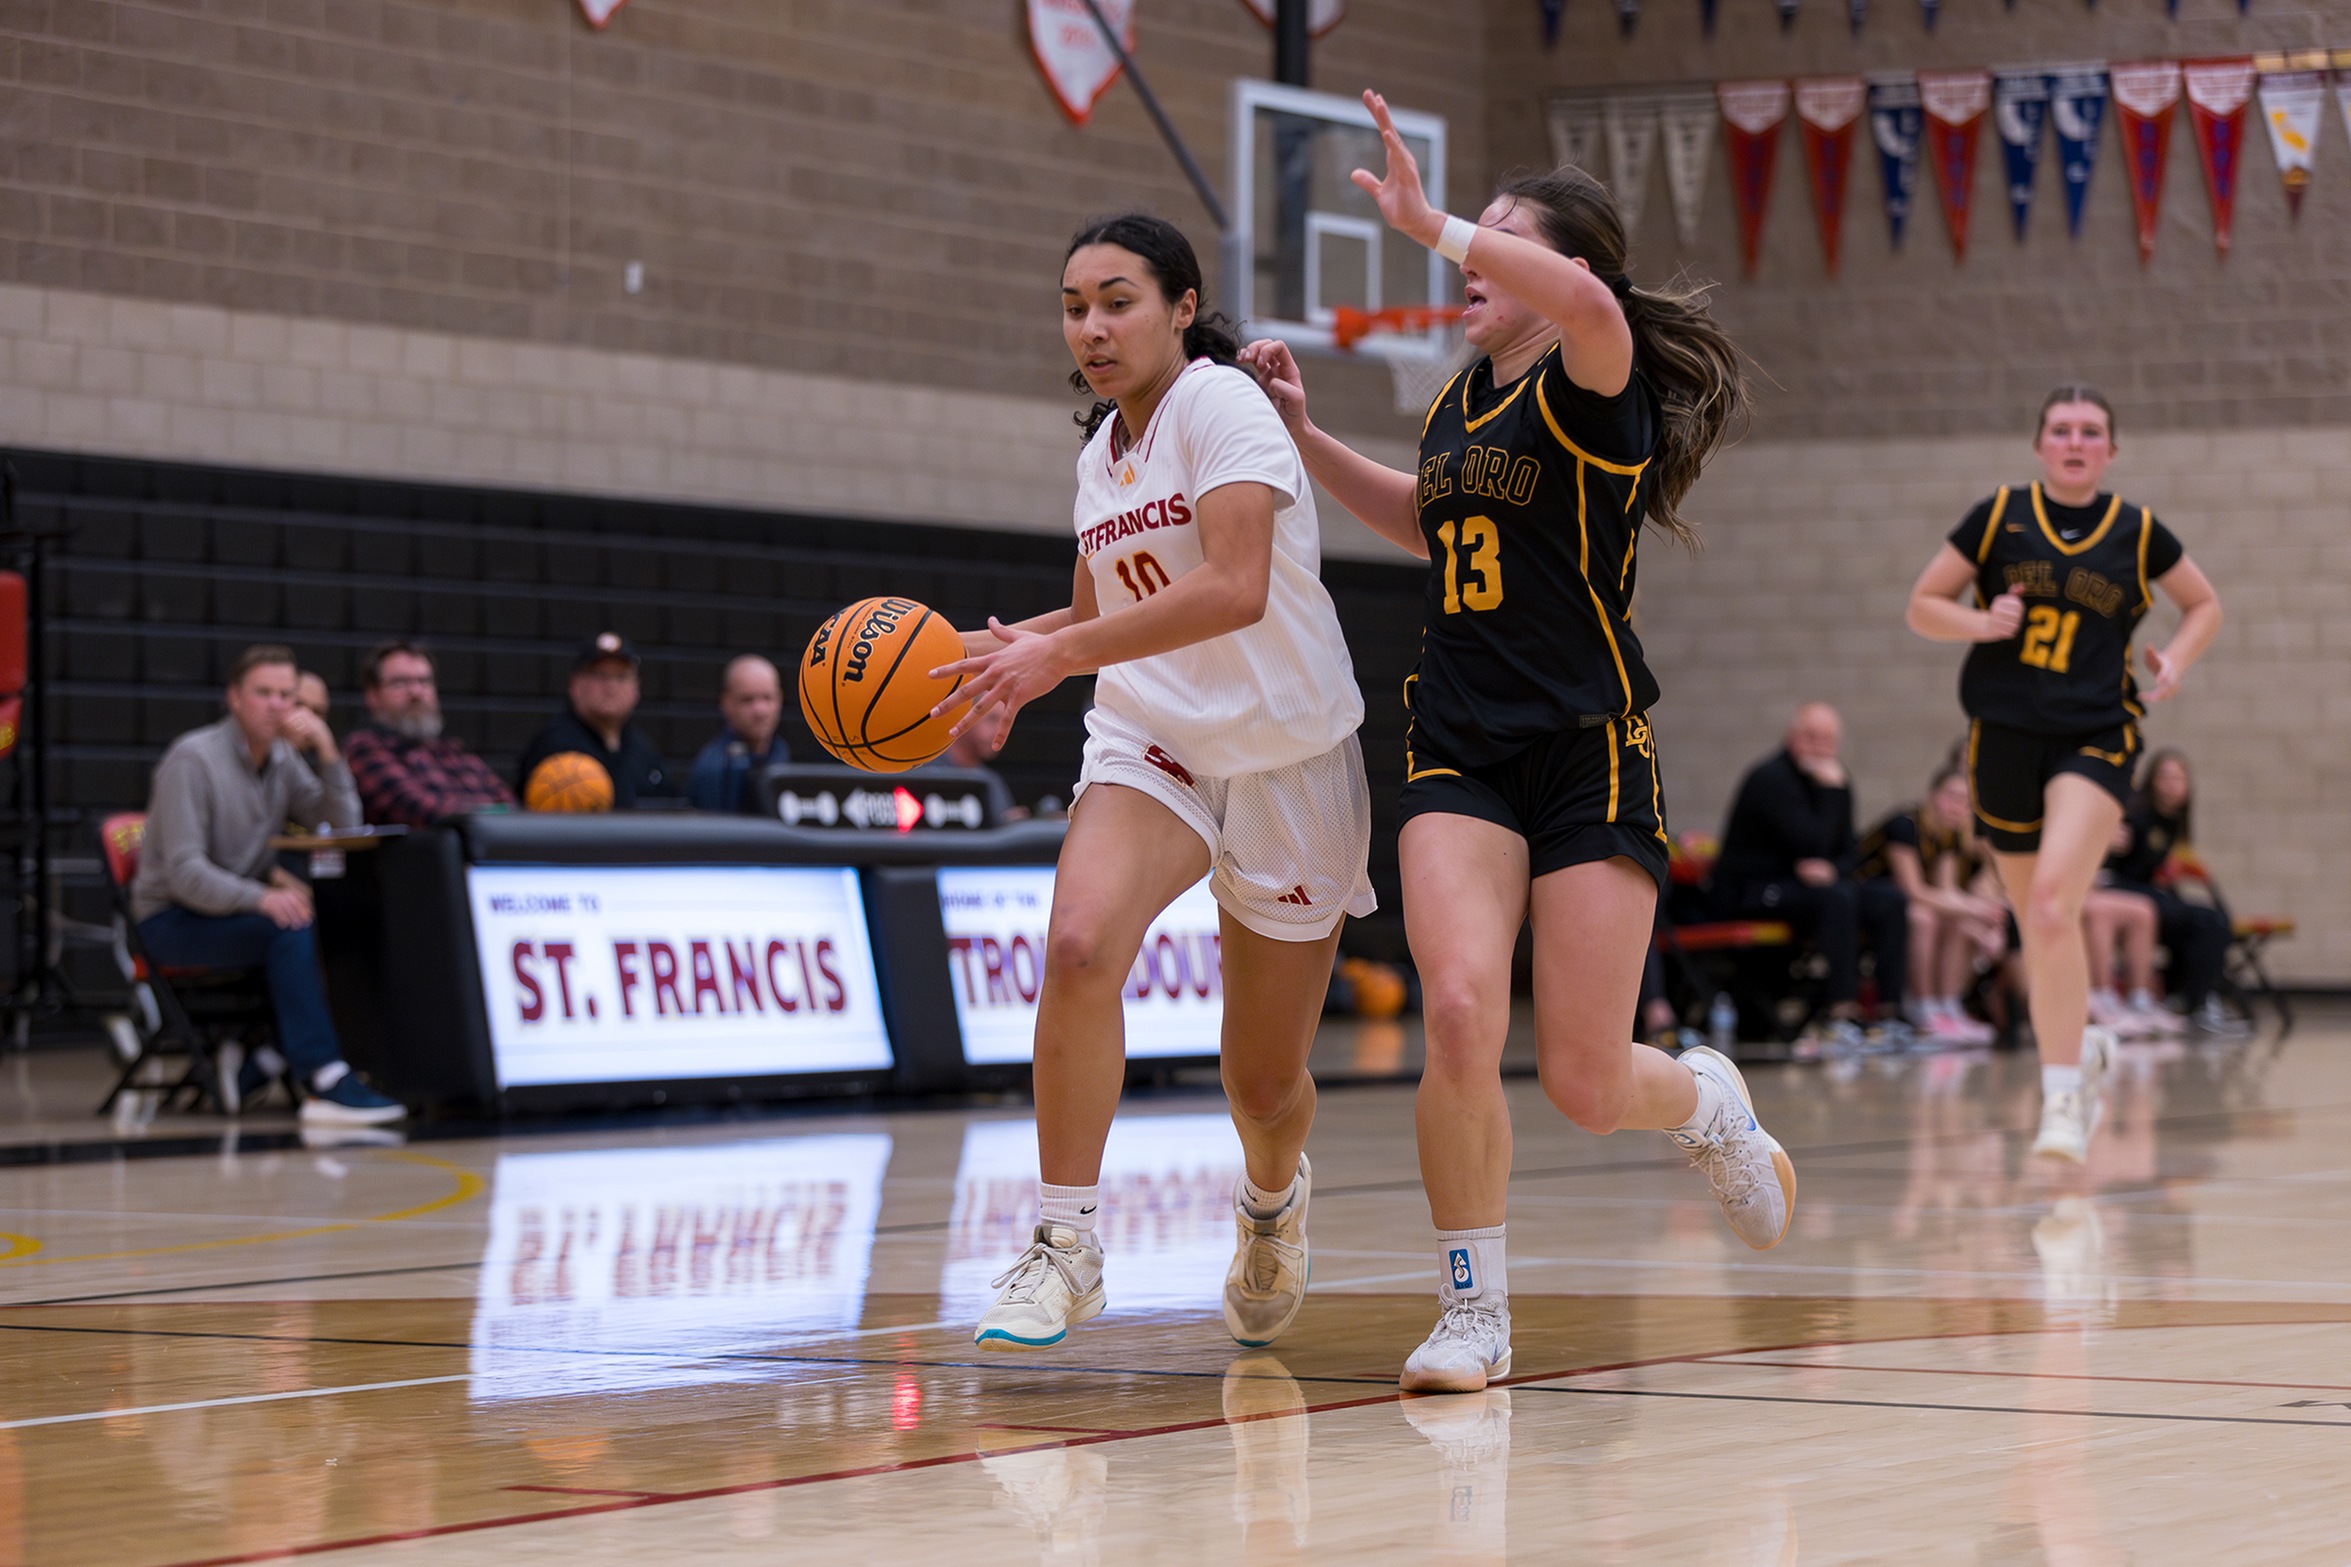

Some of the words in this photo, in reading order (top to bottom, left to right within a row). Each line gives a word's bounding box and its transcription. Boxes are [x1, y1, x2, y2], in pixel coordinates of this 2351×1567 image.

[1418, 451, 1453, 508] EL
[1461, 445, 1541, 506] ORO
[1437, 515, 1504, 615] 13
[2064, 566, 2126, 619] ORO
[843, 599, 919, 683] Wilson
[2019, 604, 2081, 675] 21
[511, 940, 598, 1021] ST.
[611, 938, 848, 1015] FRANCIS
